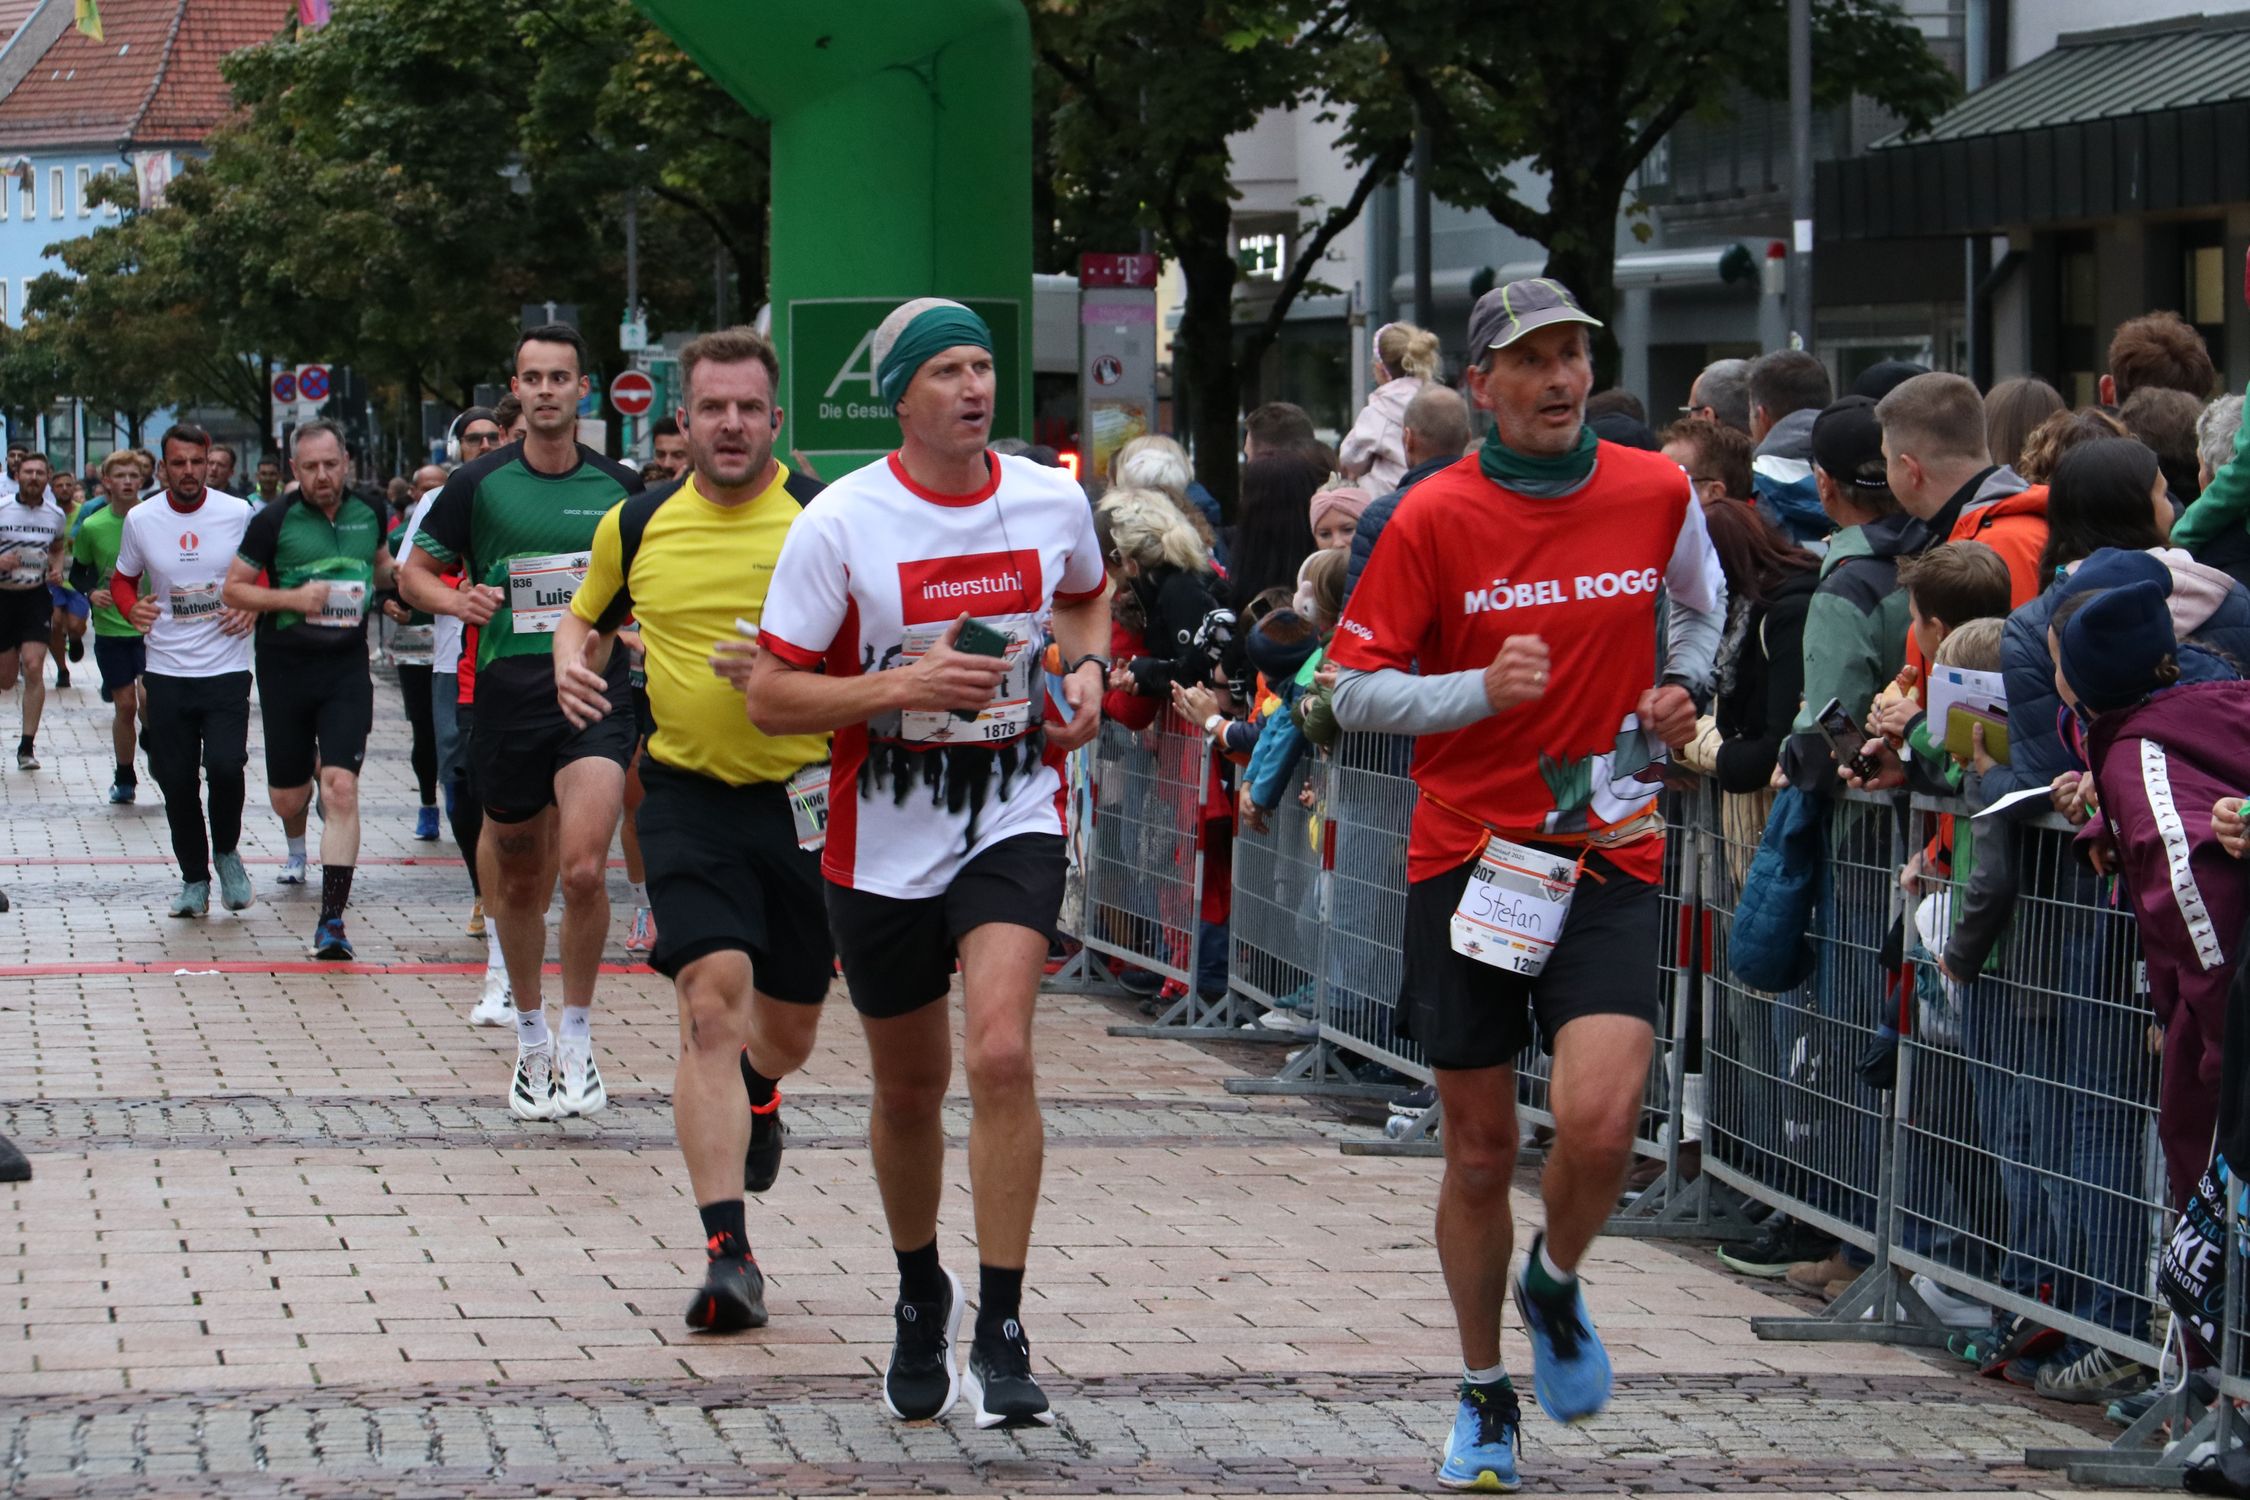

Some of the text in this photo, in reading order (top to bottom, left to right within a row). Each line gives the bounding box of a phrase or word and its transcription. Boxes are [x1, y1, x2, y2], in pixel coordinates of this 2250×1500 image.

[819, 403, 842, 419] Die
[512, 578, 533, 588] 836
[923, 571, 1023, 600] interstuhl
[1464, 567, 1658, 615] MÖBEL ROGG
[536, 588, 573, 607] Luis
[171, 600, 222, 617] Matheus
[321, 604, 357, 619] ürgen
[1343, 619, 1374, 640] ROGG
[983, 722, 1016, 739] 1878
[816, 809, 829, 830] P
[1472, 864, 1496, 885] 207
[1472, 885, 1542, 932] Stefan
[2165, 1254, 2203, 1298] ATHON
